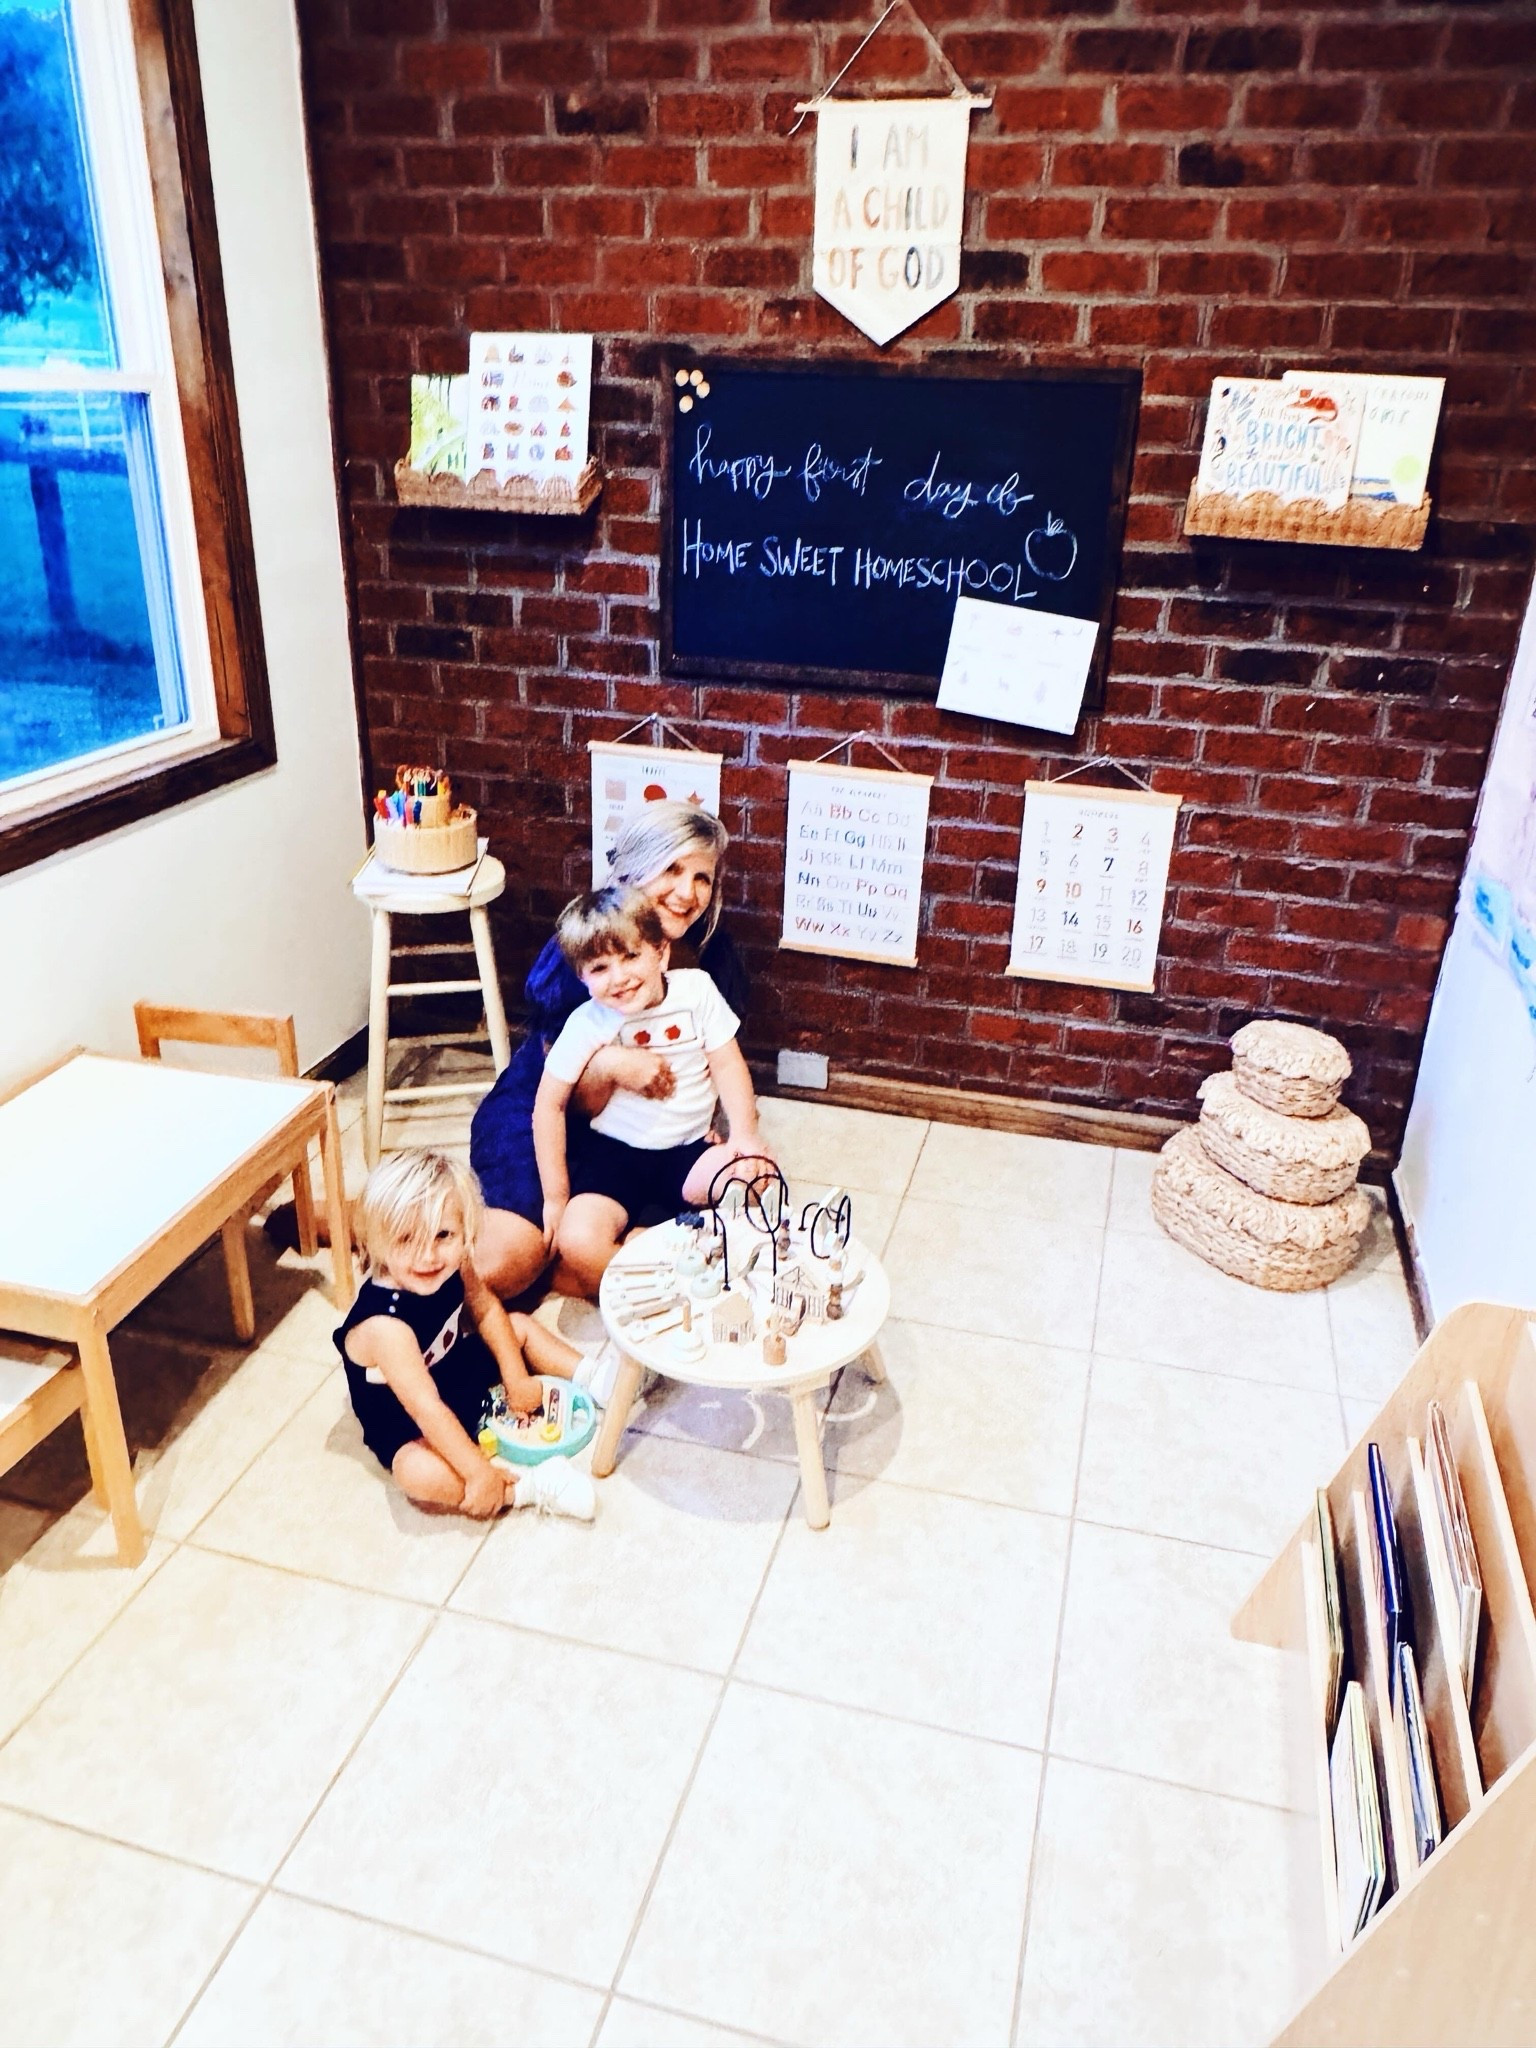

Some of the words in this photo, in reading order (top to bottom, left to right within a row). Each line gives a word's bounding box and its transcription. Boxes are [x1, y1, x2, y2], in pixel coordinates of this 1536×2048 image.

[851, 124, 859, 169] I
[882, 123, 929, 171] AM
[832, 187, 852, 231] A
[862, 184, 949, 231] CHILD
[828, 248, 864, 290] OF
[877, 246, 944, 291] GOD
[1245, 418, 1326, 452] BRIGHT
[689, 423, 792, 500] happy
[904, 451, 979, 519] day
[987, 472, 1035, 516] of
[1226, 460, 1325, 494] BEAUTIFUL
[683, 517, 752, 579] HOME
[759, 535, 844, 588] SWEET
[853, 547, 1038, 601] HOMESCHOOL
[829, 802, 852, 819] Bb
[844, 830, 866, 849] Gg
[1072, 823, 1084, 840] 2
[1107, 827, 1119, 843] 3
[872, 859, 902, 874] Mm
[1040, 851, 1049, 865] 5
[1069, 853, 1079, 868] 6
[1103, 857, 1114, 872] 7
[797, 872, 820, 887] Nn
[856, 878, 877, 896] Pp
[1035, 878, 1047, 894] 9
[1065, 881, 1082, 899] 10
[1131, 889, 1148, 906] 12
[796, 916, 824, 933] Ww
[830, 920, 850, 936] Xx
[883, 930, 903, 942] Zz
[1031, 908, 1046, 922] 13
[1062, 910, 1079, 927] 14
[1096, 915, 1111, 931] 15
[1127, 918, 1144, 935] 16
[1030, 935, 1045, 950] 17
[1061, 939, 1077, 954] 18
[1093, 943, 1108, 958] 19
[1122, 946, 1142, 963] 20
